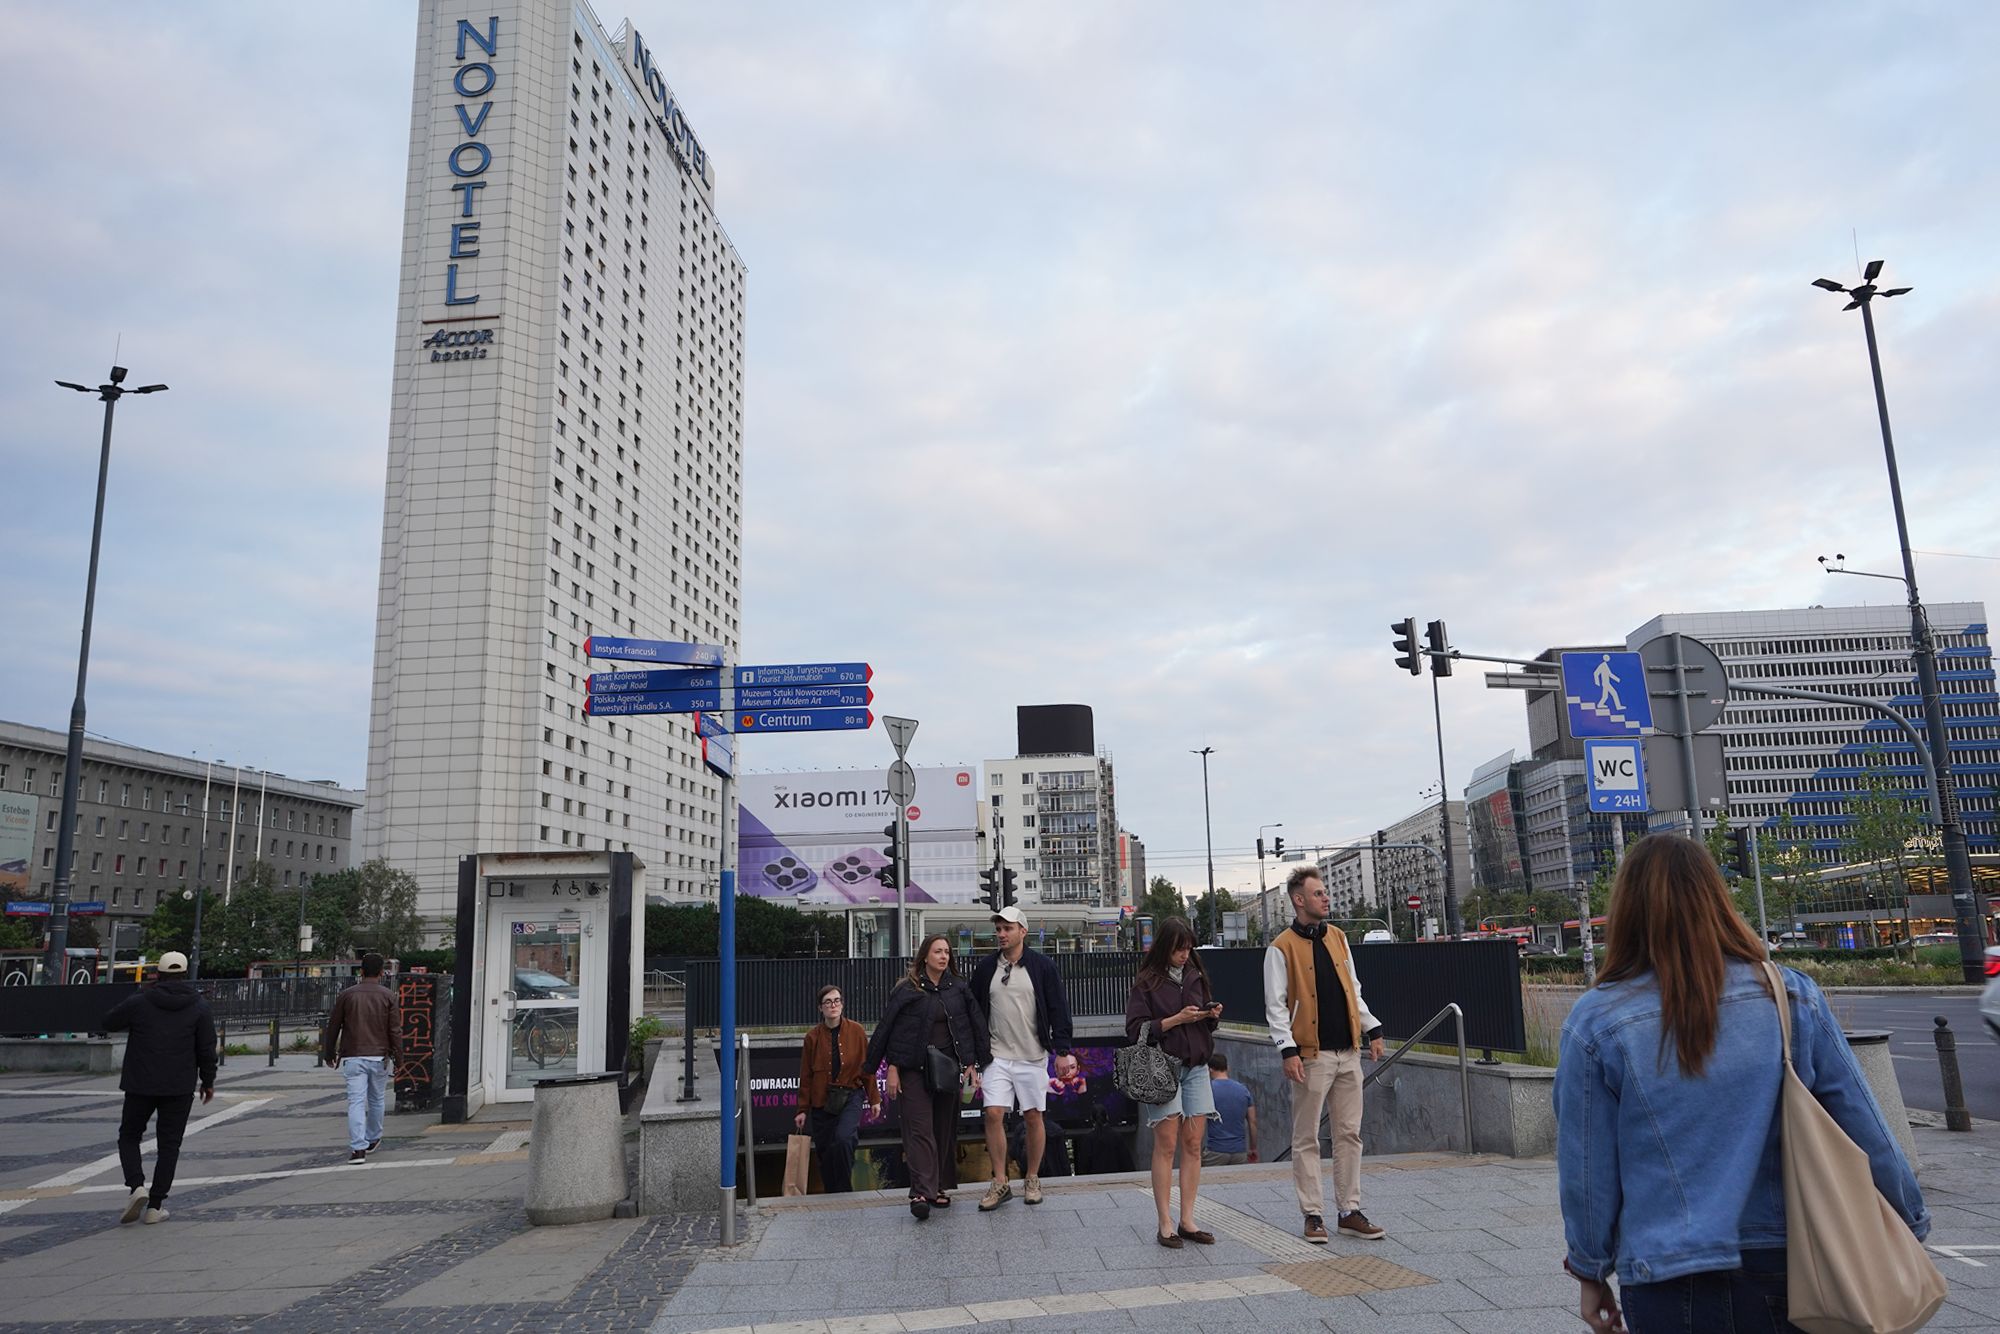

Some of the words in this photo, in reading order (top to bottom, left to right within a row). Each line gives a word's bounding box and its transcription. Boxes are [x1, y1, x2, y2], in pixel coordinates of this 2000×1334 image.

[634, 30, 711, 191] NOVOTEL
[444, 16, 499, 306] NOVOTEL
[430, 346, 488, 363] hotels
[595, 644, 623, 655] Instytut
[624, 646, 657, 657] Francuski
[696, 650, 709, 660] 240
[757, 667, 794, 676] Informacja
[797, 665, 837, 675] Turystyczna
[613, 672, 648, 681] Królewski
[758, 675, 781, 683] Tourist
[783, 674, 823, 682] Information
[840, 672, 854, 681] 670
[595, 683, 607, 692] The
[609, 681, 629, 692] Royal
[630, 681, 648, 690] Road
[690, 679, 704, 687] 650
[741, 689, 772, 698] Muzeum
[773, 688, 794, 698] Sztuki
[795, 687, 841, 698] Nowoczesnej
[594, 695, 615, 704] Polska
[617, 694, 645, 703] Agencja
[691, 700, 705, 708] 350
[741, 698, 772, 706] Museum
[773, 697, 781, 706] of
[782, 697, 809, 705] Modern
[810, 696, 822, 704] Art
[840, 696, 854, 704] 470
[593, 703, 628, 713] Inwestycji
[633, 702, 658, 711] Handlu
[659, 701, 673, 710] S.A.
[759, 713, 812, 727] Centrum
[845, 716, 854, 725] 80
[1598, 759, 1634, 778] WC
[873, 790, 891, 805] 17
[1614, 795, 1641, 807] 24H
[2, 804, 31, 816] Esteban
[752, 1094, 779, 1107] YLKO
[782, 1091, 798, 1106] ŚM
